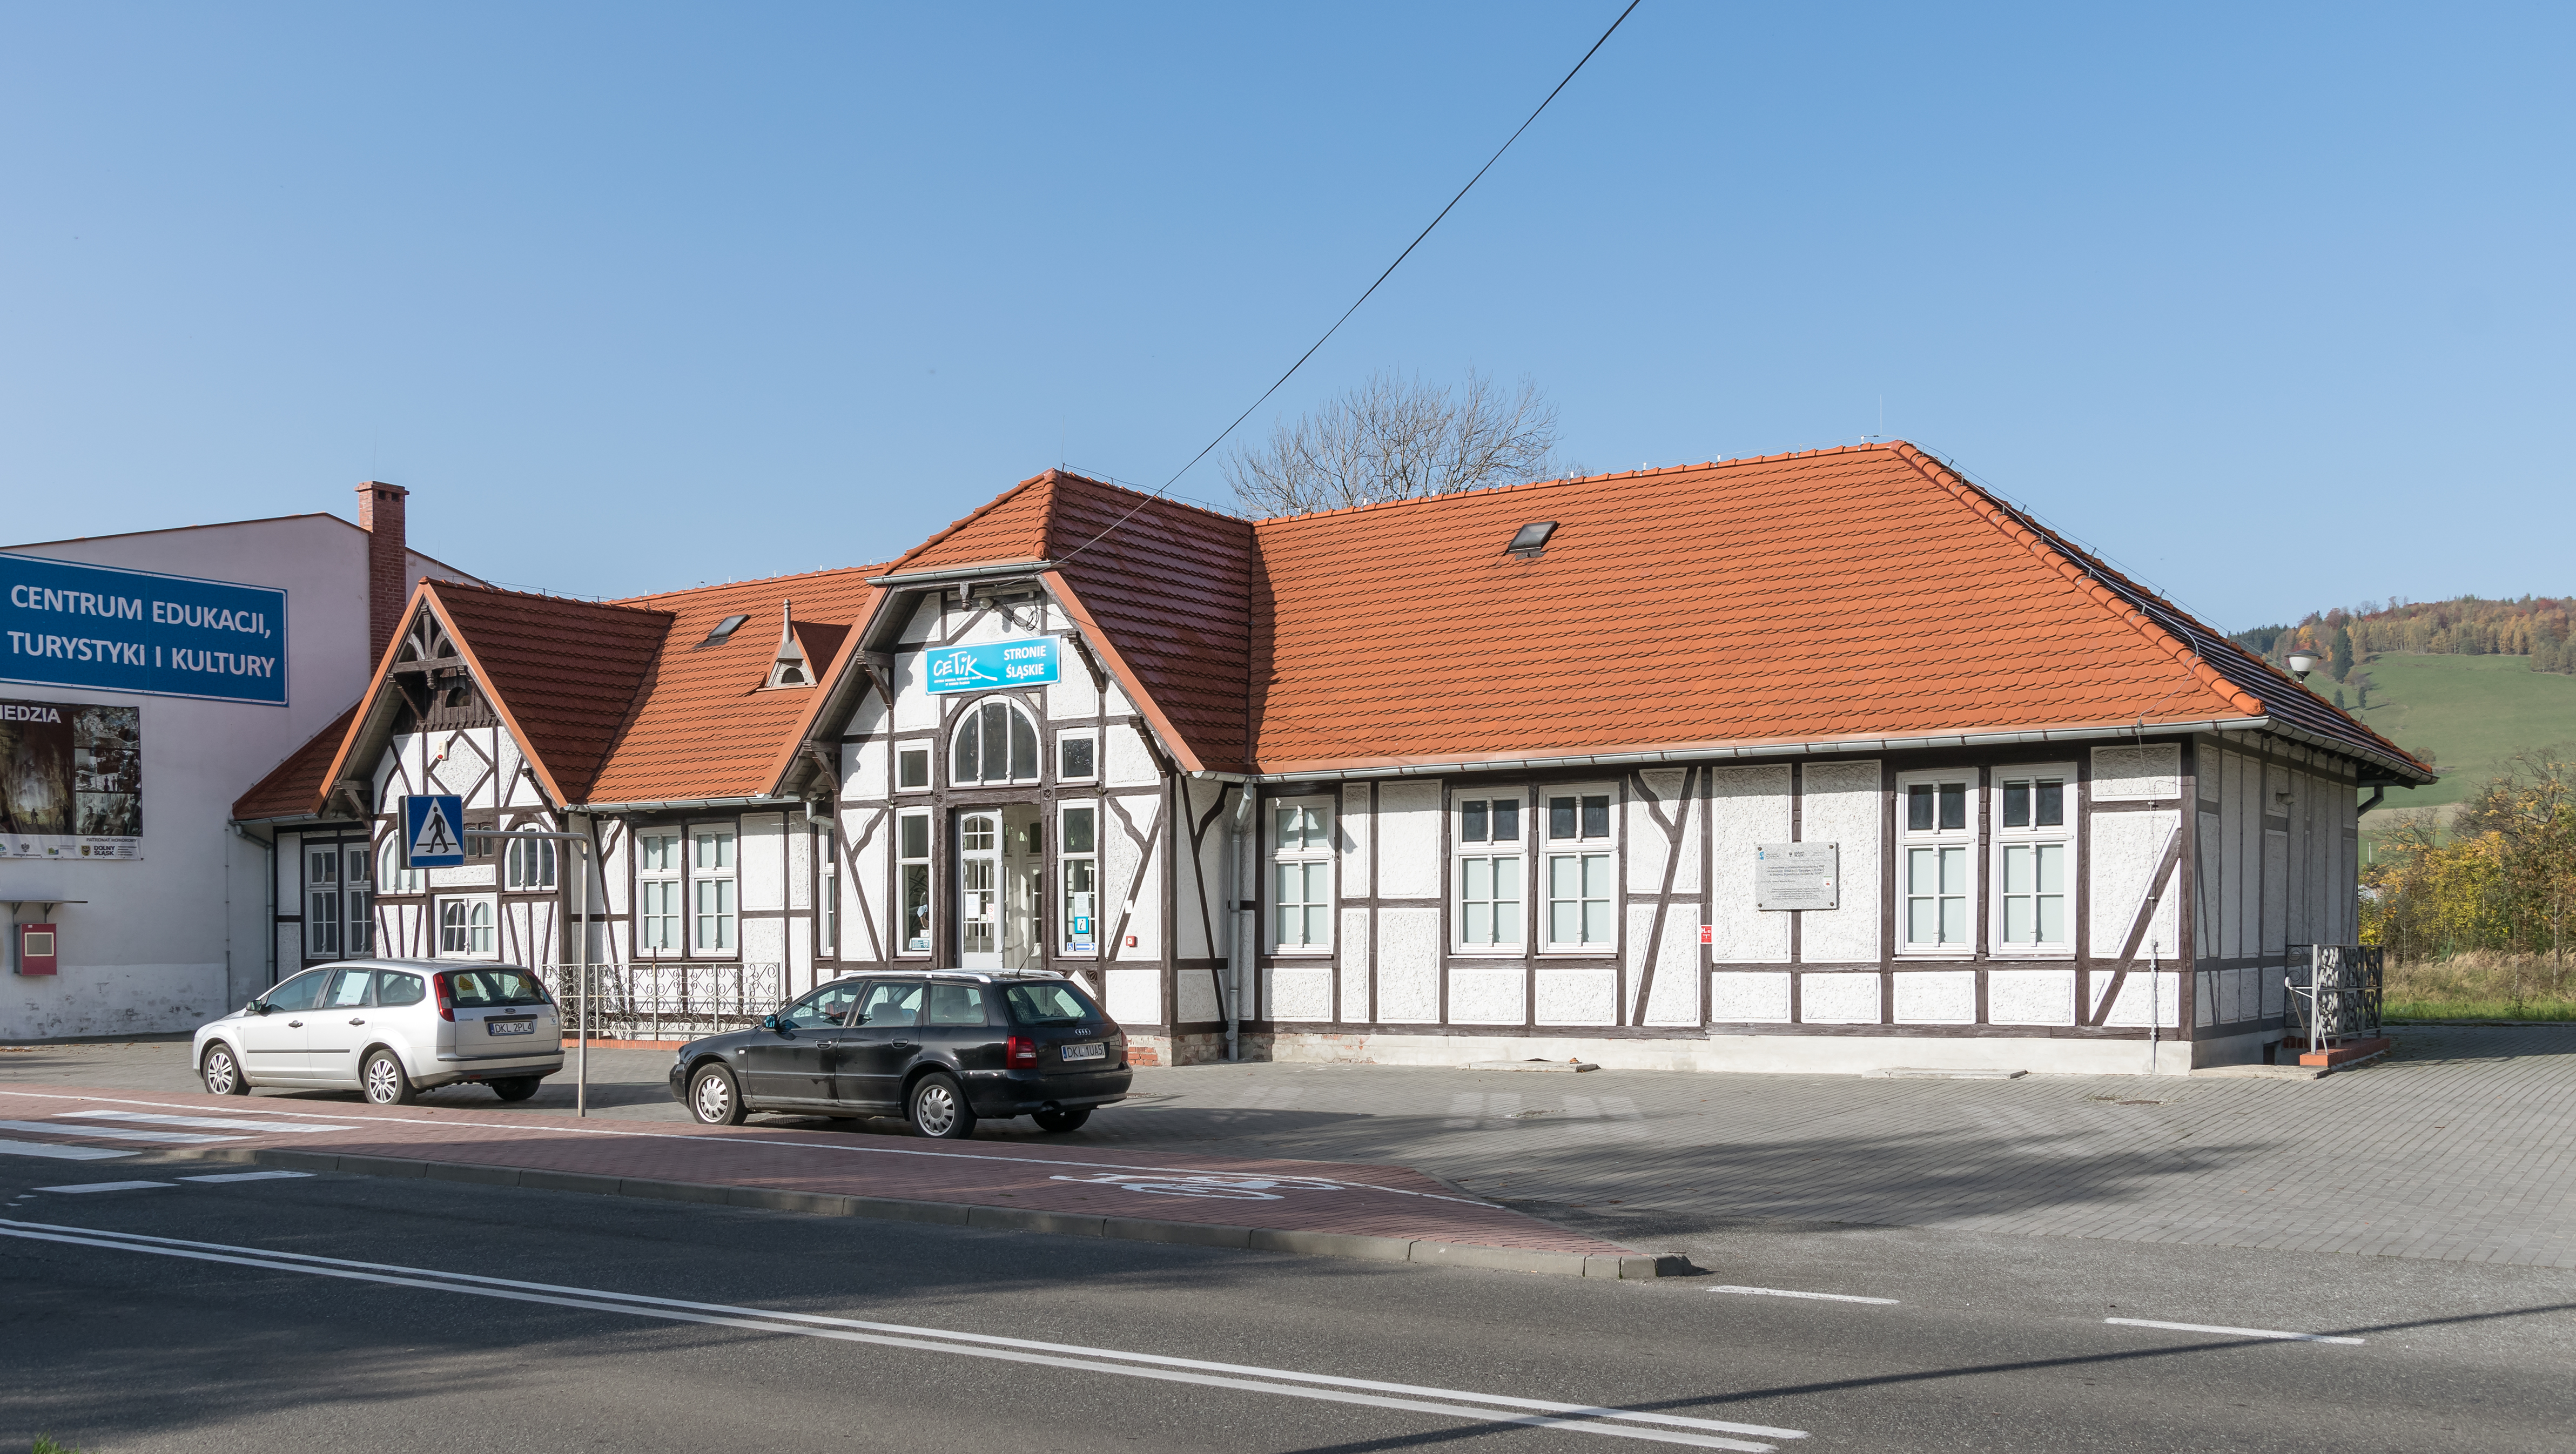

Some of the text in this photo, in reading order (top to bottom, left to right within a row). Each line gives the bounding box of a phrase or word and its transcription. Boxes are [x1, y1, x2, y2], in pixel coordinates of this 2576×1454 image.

[11, 584, 271, 639] CENTRUM EDUKACJI,
[7, 630, 275, 678] TURYSTYKI I KULTURY
[1004, 645, 1047, 661] STRONIE
[1006, 663, 1045, 679] ŚLĄSKIE
[495, 1022, 533, 1033] DKL 2PL4
[1067, 1045, 1102, 1058] DKL 1UA5
